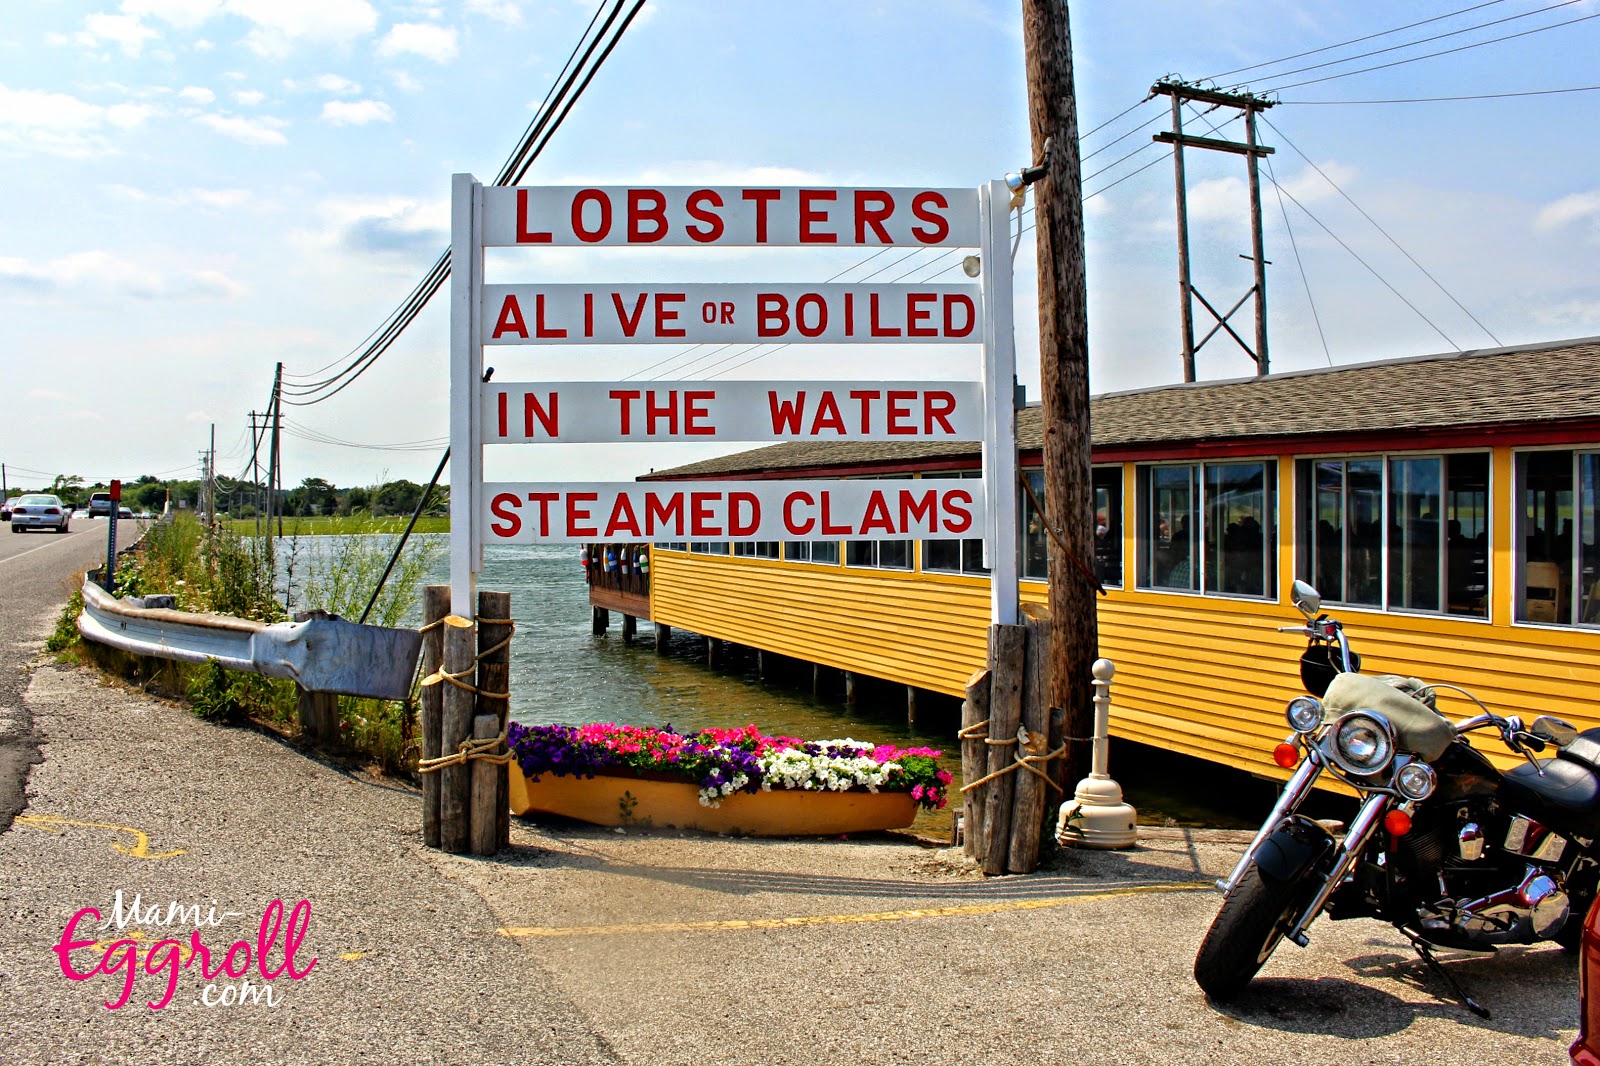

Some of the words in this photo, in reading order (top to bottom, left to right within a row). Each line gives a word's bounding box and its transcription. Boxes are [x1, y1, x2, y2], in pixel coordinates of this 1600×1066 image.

[517, 188, 949, 244] LOBSTERS
[492, 293, 686, 339] ALIVE
[702, 302, 735, 325] OR
[757, 293, 975, 338] BOILED
[498, 392, 559, 437] IN
[609, 390, 716, 435] THE
[768, 390, 956, 435] WATER
[491, 491, 761, 537] STEAMED
[783, 489, 973, 536] CLAMS
